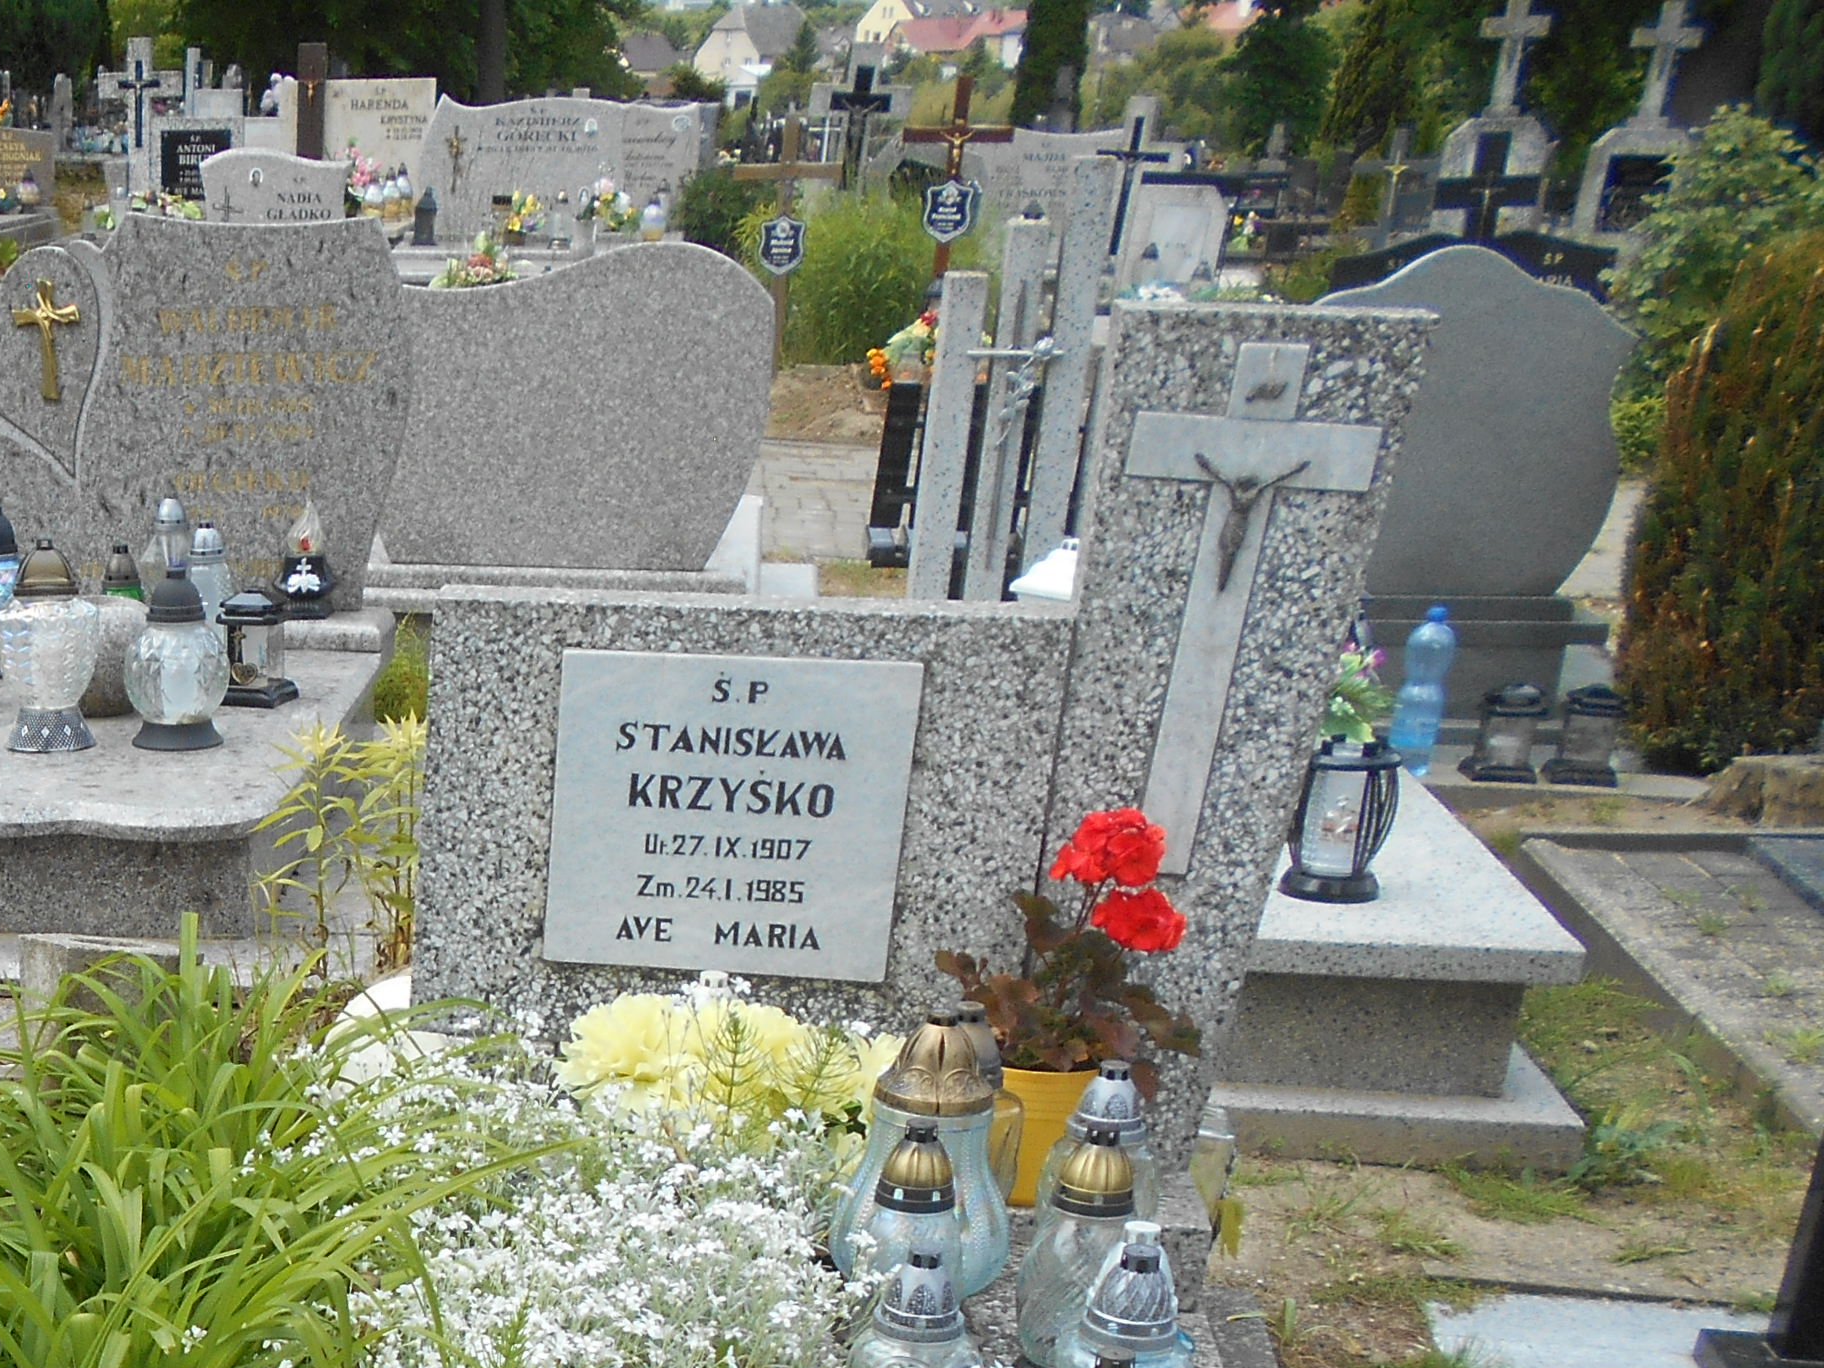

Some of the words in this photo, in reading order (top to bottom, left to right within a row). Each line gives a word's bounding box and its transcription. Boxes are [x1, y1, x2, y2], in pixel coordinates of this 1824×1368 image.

[350, 99, 410, 111] HARENDA
[176, 144, 216, 153] ANTONI
[277, 192, 323, 205] NADIA
[615, 720, 847, 762] STANISŁAWA
[628, 769, 836, 819] KRZYŚKO
[615, 914, 674, 943] AVE
[714, 921, 822, 951] MARIA
